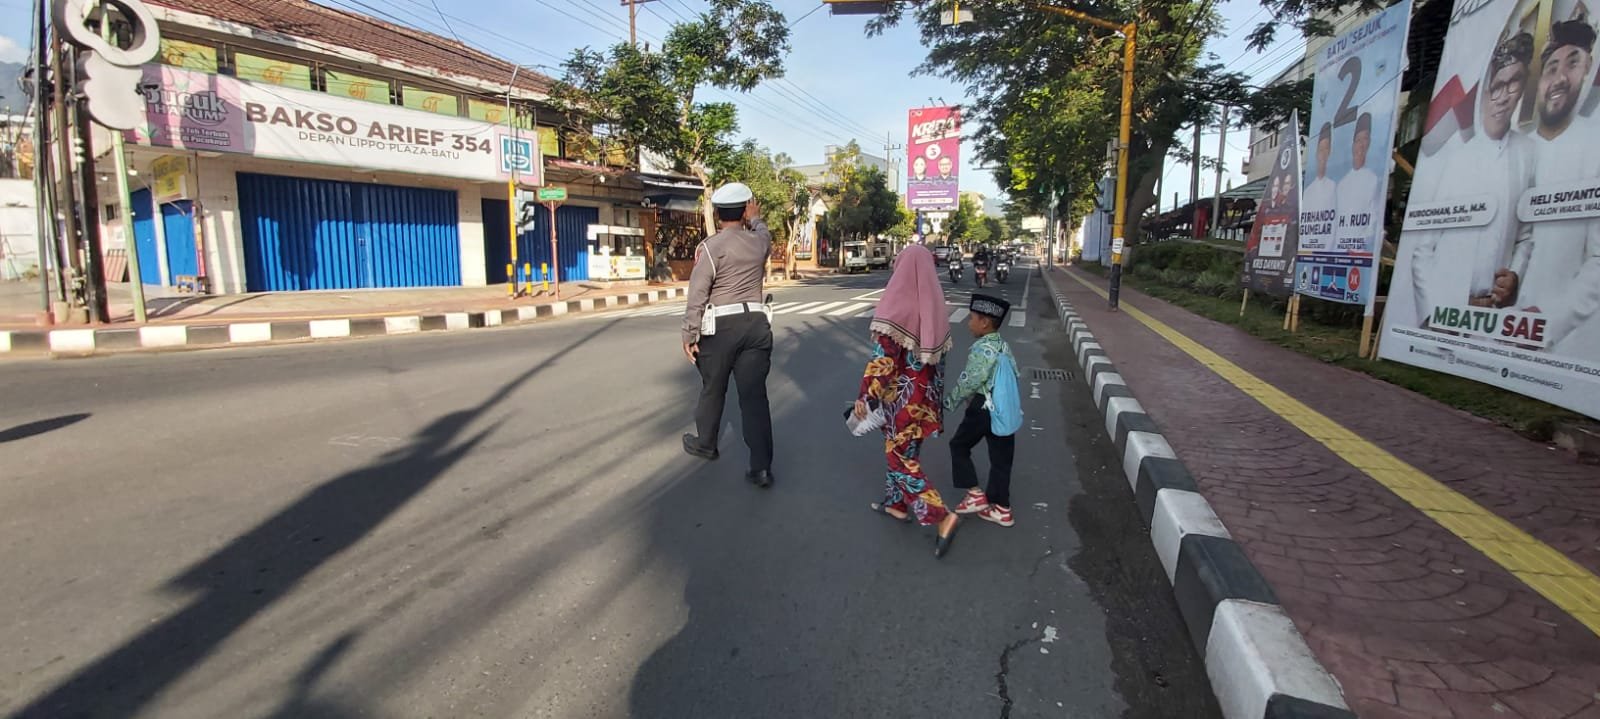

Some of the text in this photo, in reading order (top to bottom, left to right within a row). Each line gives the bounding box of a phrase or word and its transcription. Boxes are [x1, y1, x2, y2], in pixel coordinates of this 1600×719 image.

[1327, 37, 1348, 59] BATU
[1333, 56, 1362, 129] 2
[246, 102, 492, 155] BAKSO ARIEF 354
[298, 131, 460, 160] DEPAN LIPPO PLAZA-BATU
[1530, 193, 1552, 206] HELI
[1300, 209, 1336, 223] FIRHANDO
[1534, 207, 1557, 216] CALON
[1350, 213, 1372, 227] RUDI
[1299, 223, 1332, 235] GUMELAR
[1346, 291, 1359, 302] PKS
[1432, 305, 1547, 342] MBATU SAE
